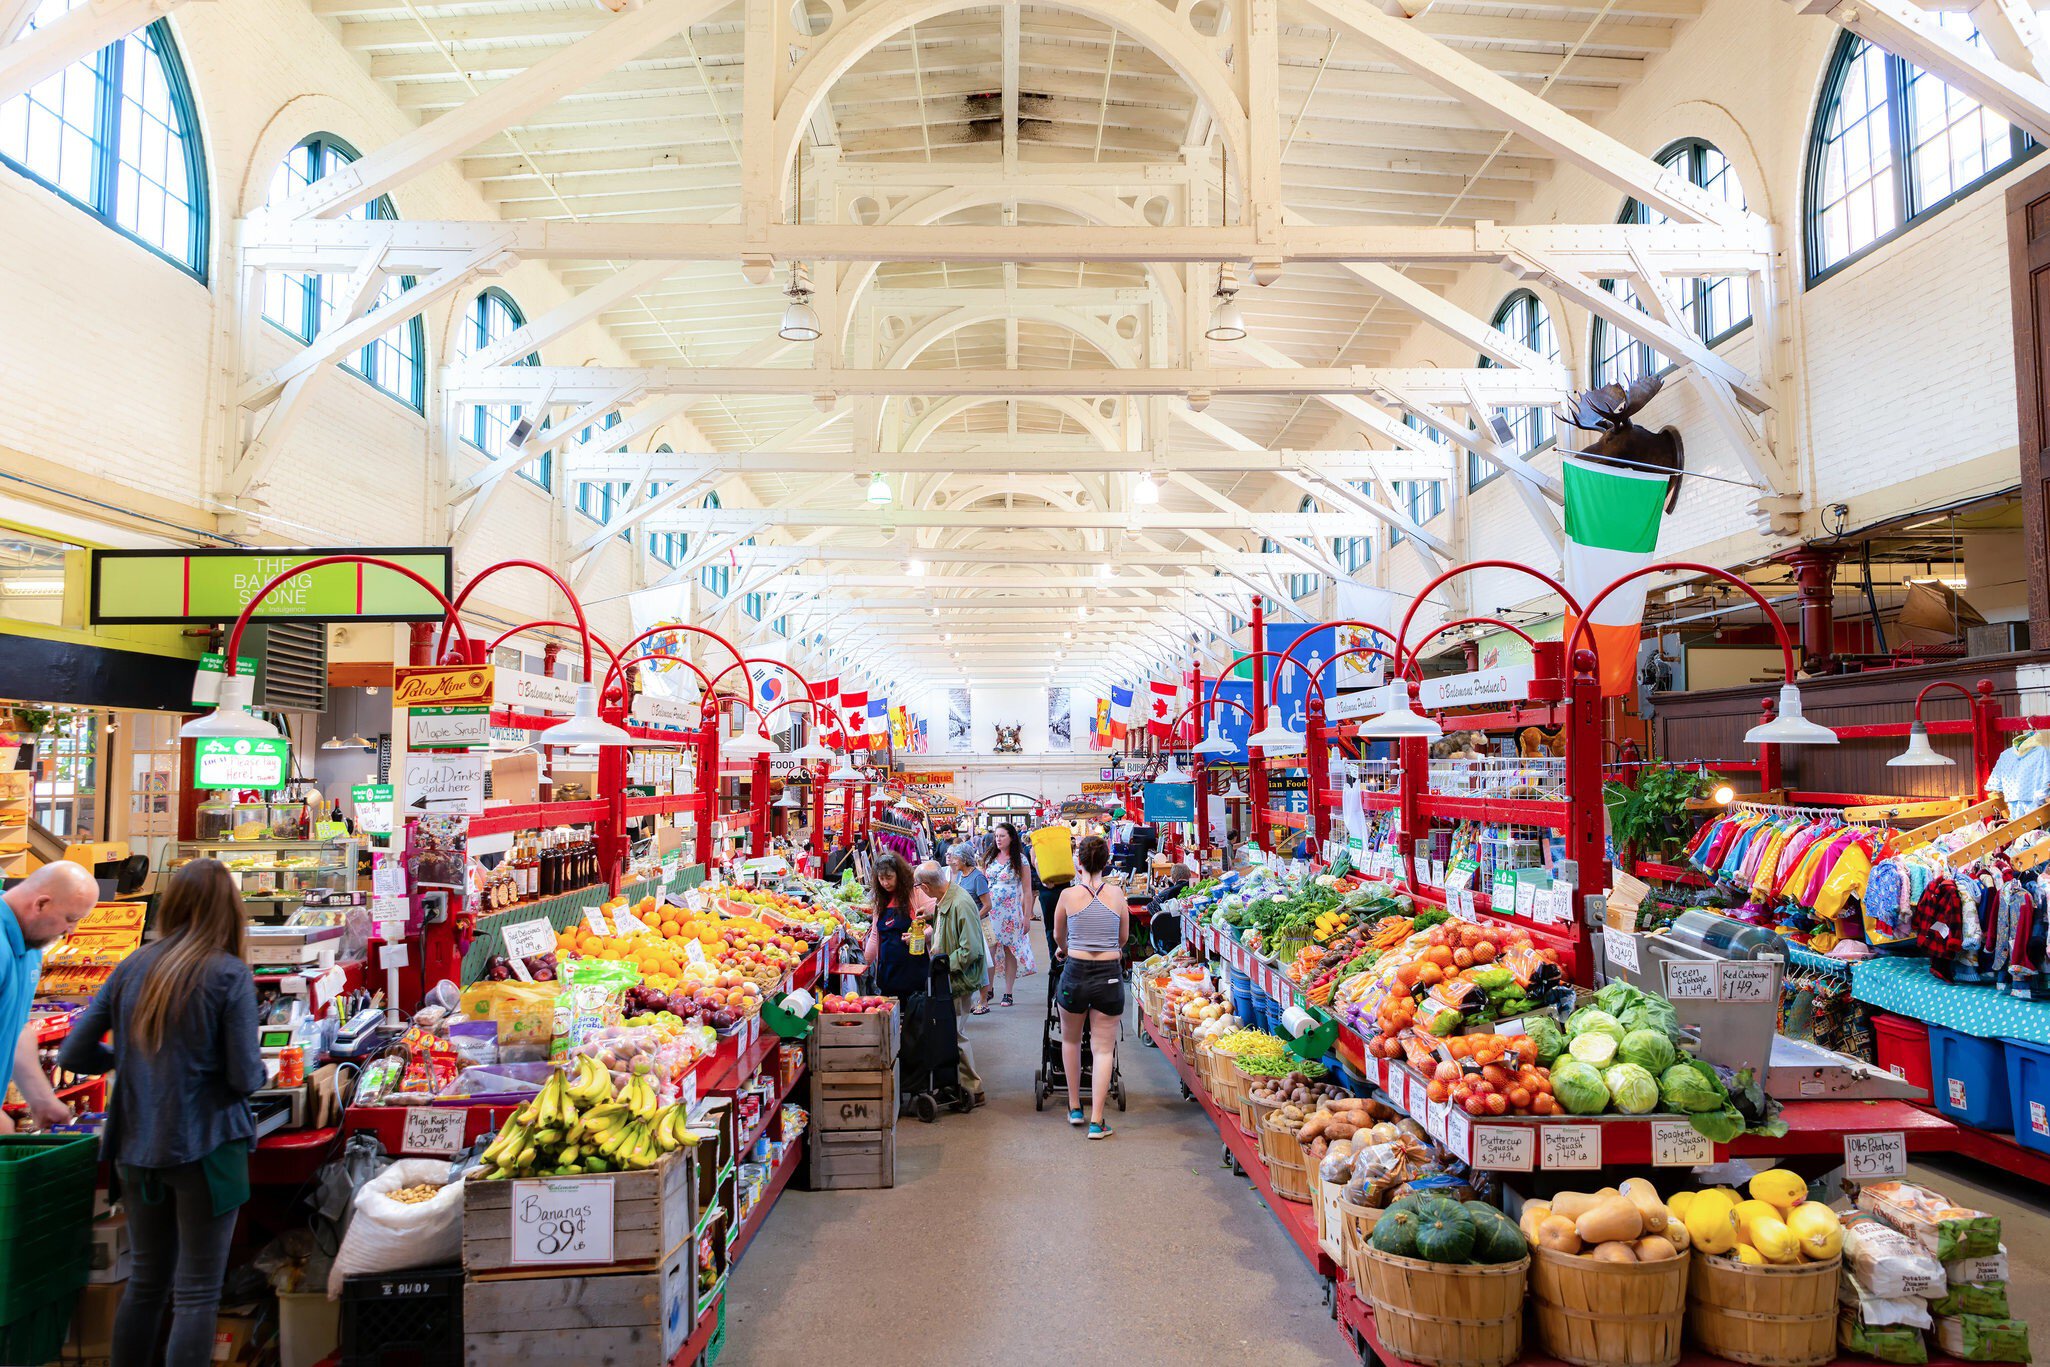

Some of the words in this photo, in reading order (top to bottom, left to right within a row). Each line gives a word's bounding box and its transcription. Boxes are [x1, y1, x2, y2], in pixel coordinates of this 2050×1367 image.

[254, 558, 292, 573] THE
[1473, 678, 1500, 697] Produce
[414, 721, 450, 739] Maple
[770, 761, 795, 769] FOOD
[408, 769, 439, 786] Cold
[439, 766, 481, 784] Drinks
[421, 783, 446, 795] sold
[449, 781, 471, 792] here
[1671, 966, 1699, 979] Green
[1723, 970, 1737, 979] Red
[1737, 970, 1769, 983] Cabbage
[1677, 975, 1708, 985] Cabbage
[409, 1114, 428, 1126] Plain
[1480, 1135, 1522, 1147] Buttercup
[1545, 1133, 1586, 1145] Butternut
[1657, 1128, 1693, 1144] Spaghetti
[1678, 1136, 1707, 1146] Squash
[1487, 1144, 1514, 1154] Squash
[1555, 1143, 1583, 1152] Squash
[1867, 1138, 1900, 1152] Potatoes
[1853, 1152, 1892, 1172] $5.99
[519, 1194, 592, 1223] Bananas
[537, 1217, 587, 1255] 89¢
